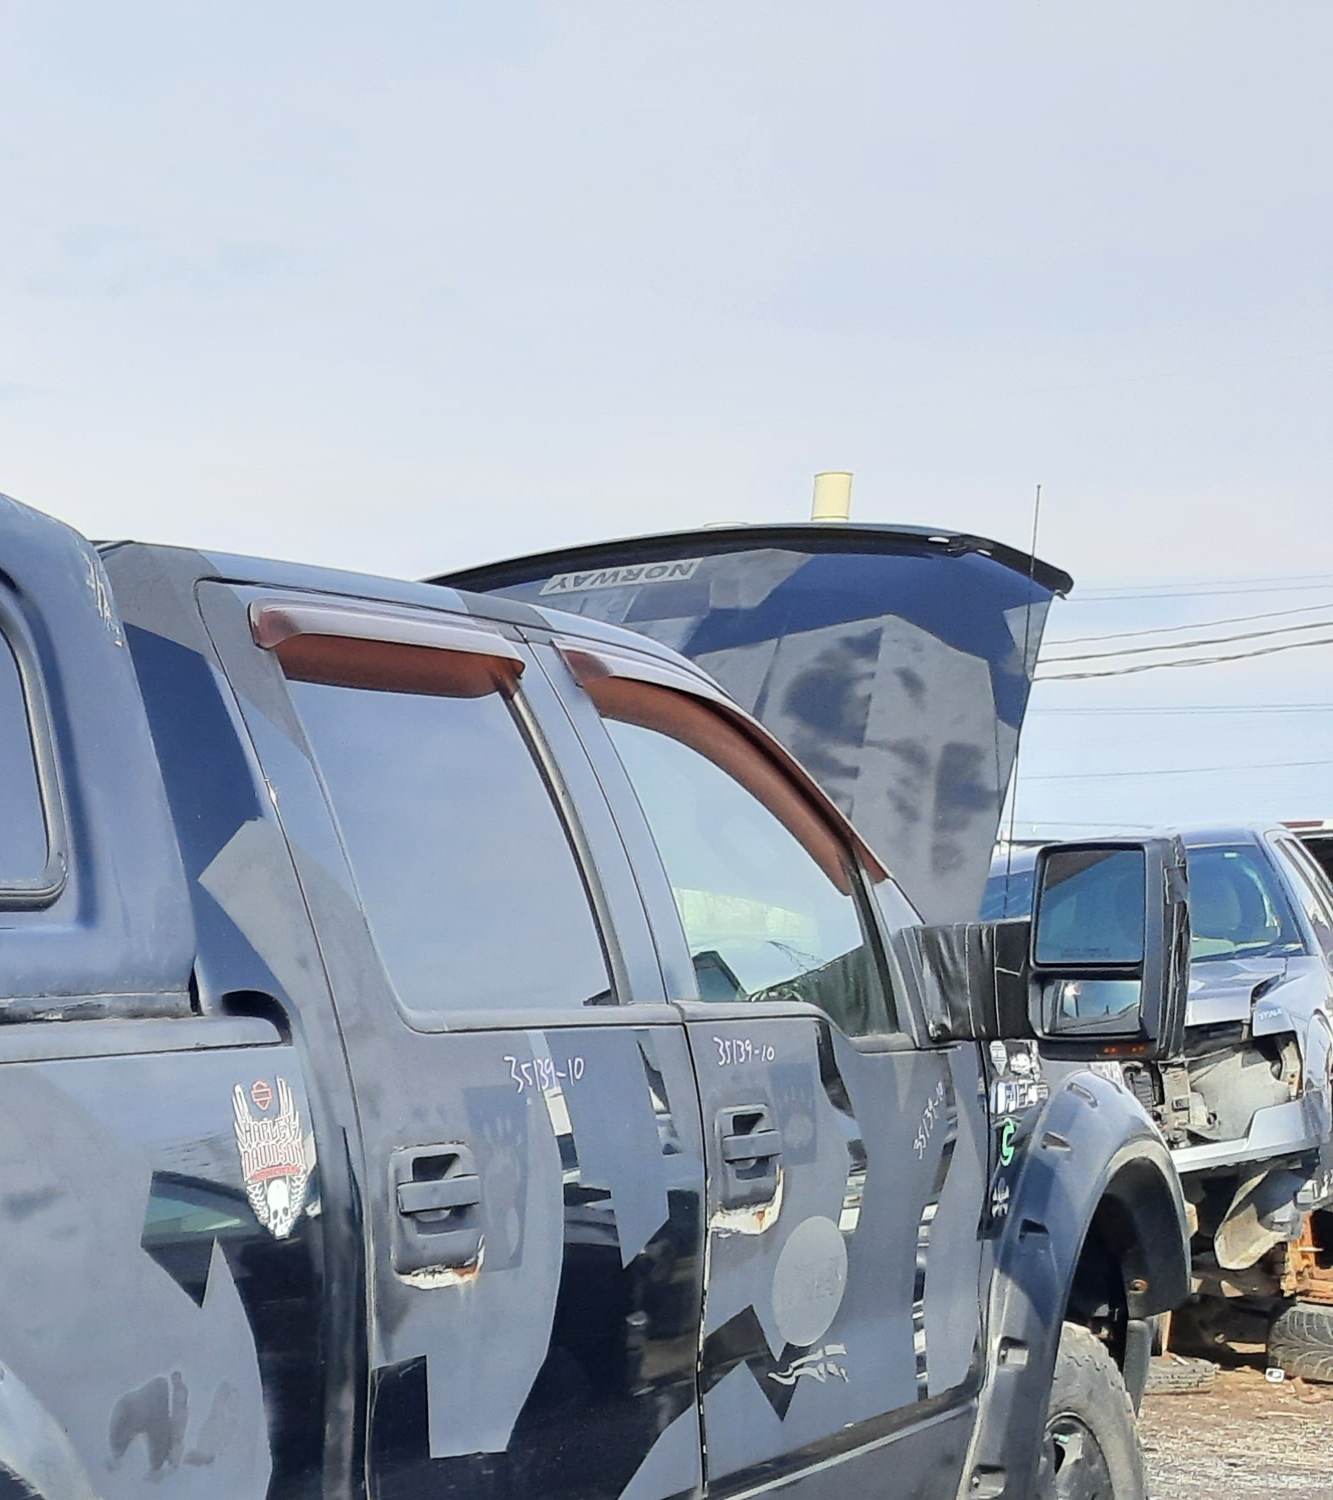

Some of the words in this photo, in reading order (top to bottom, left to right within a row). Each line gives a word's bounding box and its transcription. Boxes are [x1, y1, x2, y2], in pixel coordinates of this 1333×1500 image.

[549, 562, 694, 590] NORWAY
[713, 1037, 775, 1067] 35139-10
[503, 1056, 585, 1094] 35139-10
